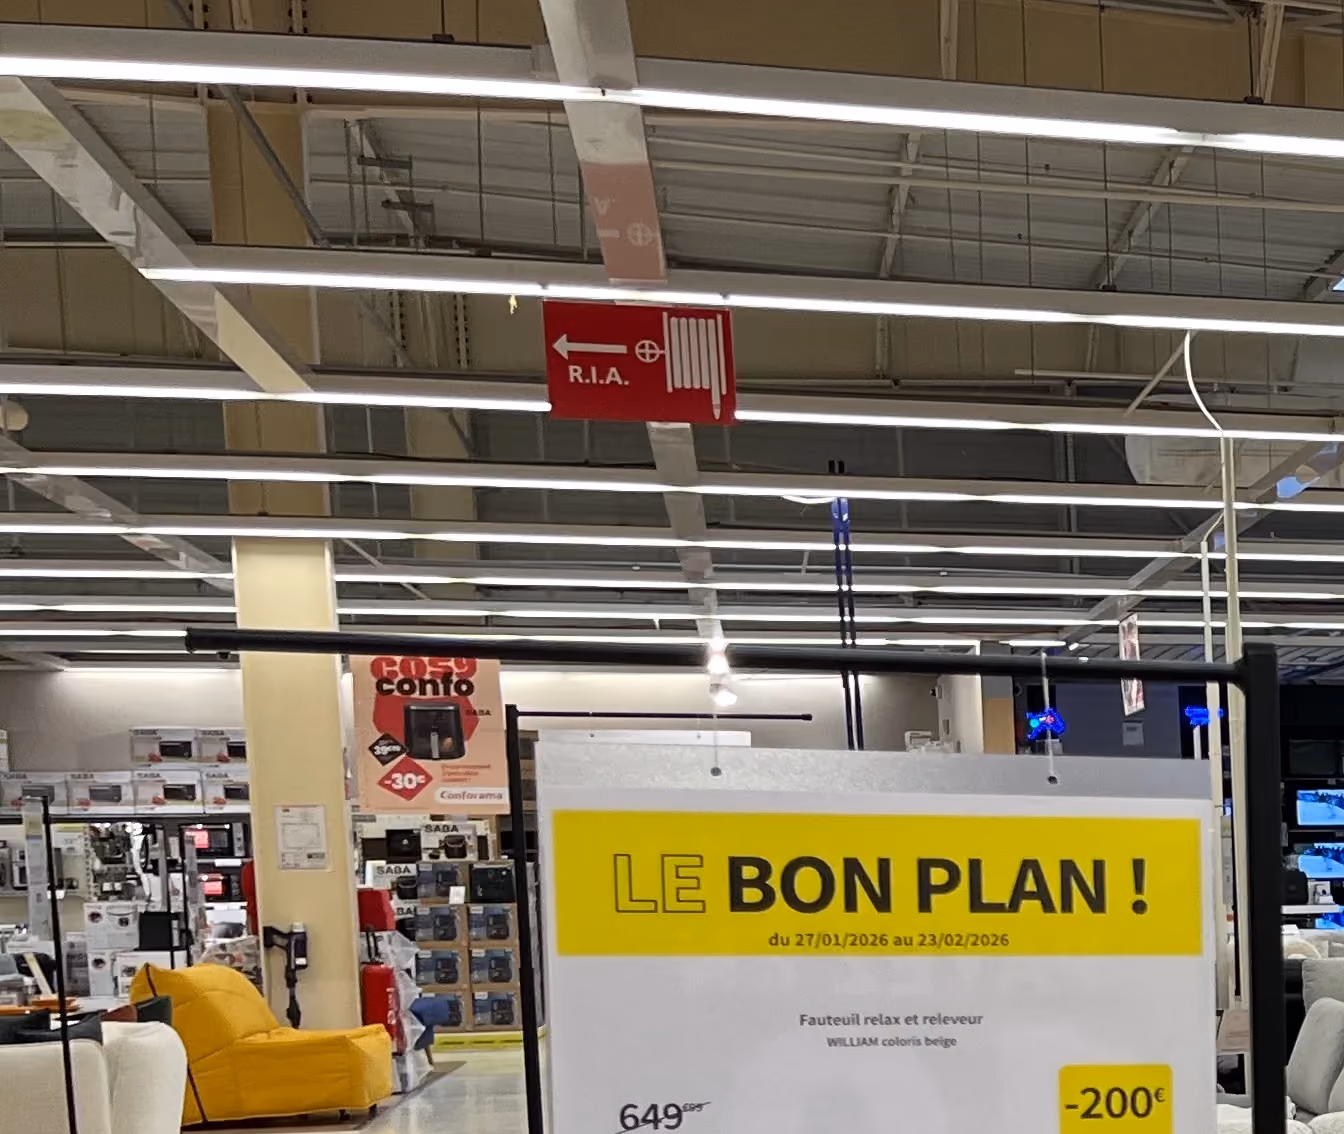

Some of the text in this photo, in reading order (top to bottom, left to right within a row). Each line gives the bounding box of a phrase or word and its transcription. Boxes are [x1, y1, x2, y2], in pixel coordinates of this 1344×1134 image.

[568, 365, 629, 385] R.I.A.
[375, 673, 475, 697] confo
[440, 790, 503, 800] Conforama
[612, 853, 706, 914] LE
[728, 854, 892, 914] BON
[917, 857, 1107, 915] PLAN
[769, 932, 1010, 949] du 27/01/2026 au 23/02/2026
[800, 1012, 984, 1026] Fauteuil relax et releveur
[827, 1036, 957, 1049] WILLIAM coloris beige
[1065, 1086, 1165, 1121] -200€
